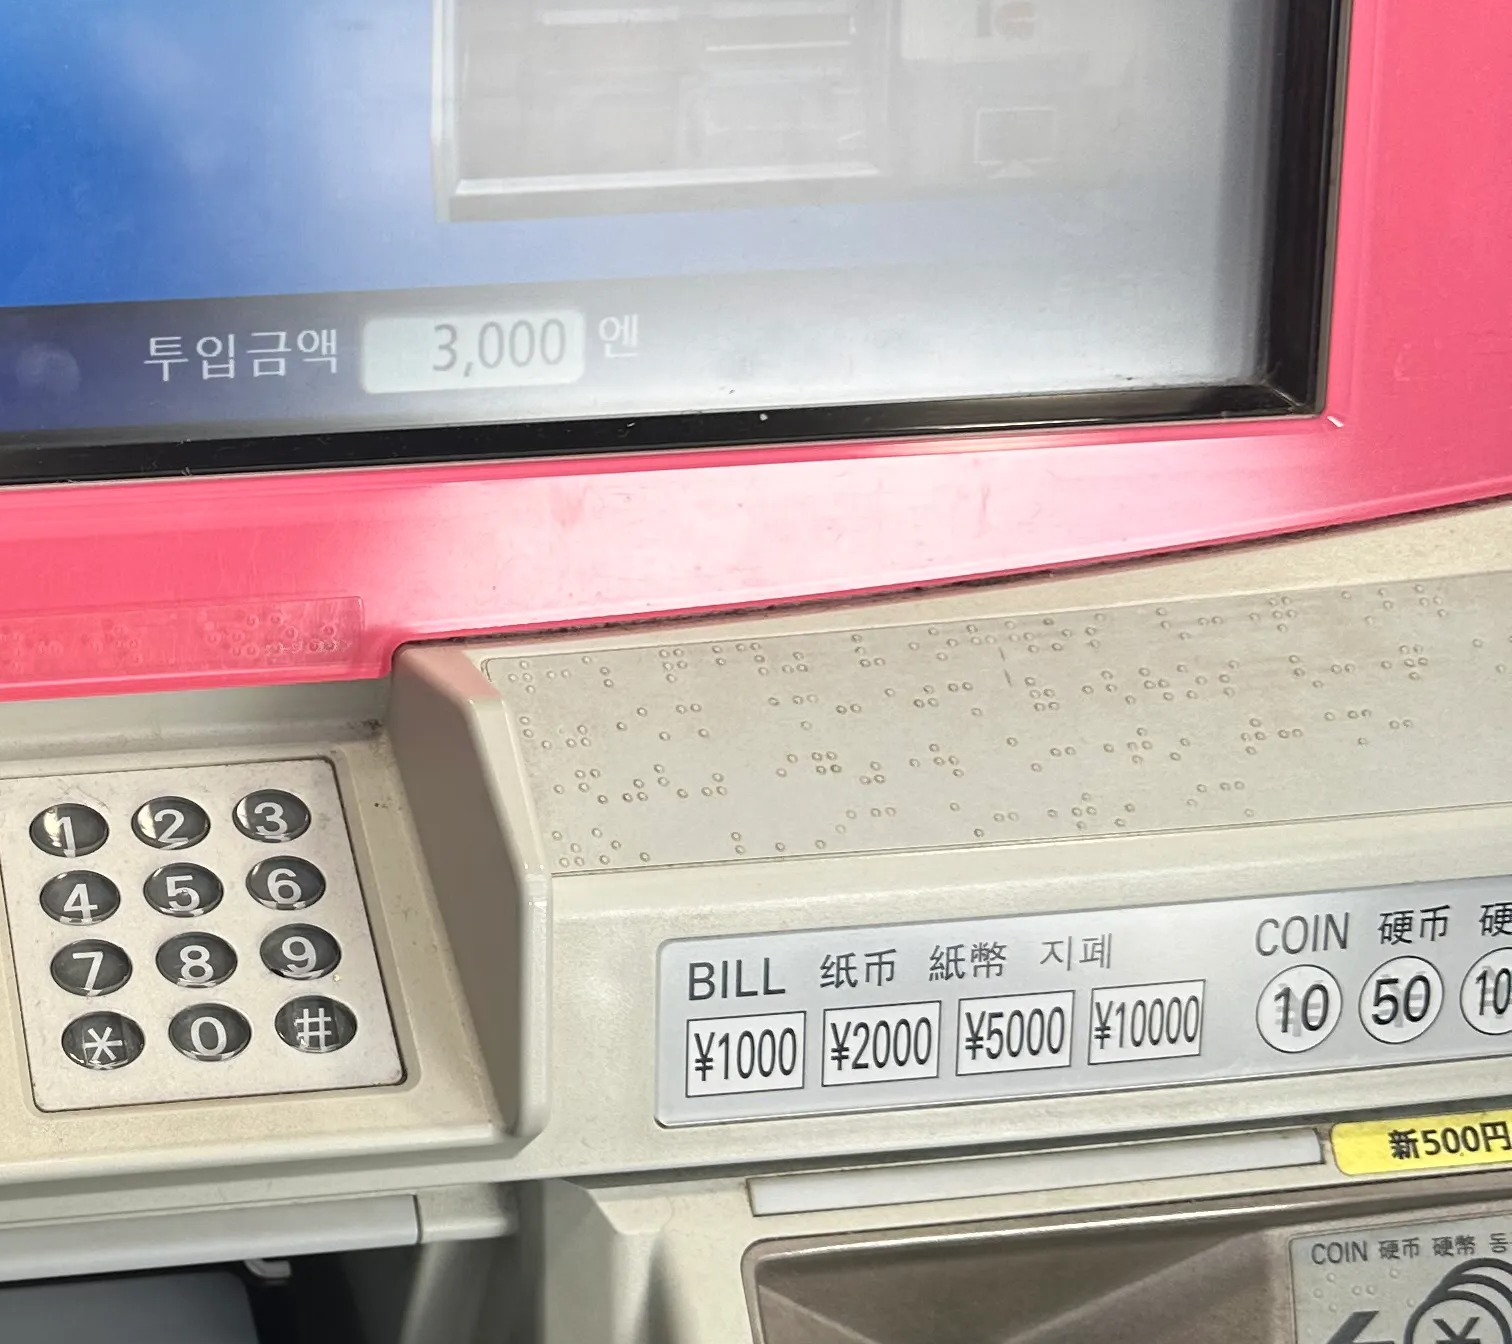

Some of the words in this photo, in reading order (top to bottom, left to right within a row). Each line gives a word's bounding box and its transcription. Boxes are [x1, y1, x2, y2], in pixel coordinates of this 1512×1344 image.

[144, 328, 339, 382] 투입금액
[431, 317, 567, 378] 3,000
[597, 314, 639, 360] 엔
[57, 816, 77, 856] 1
[155, 810, 188, 846] 2
[255, 802, 286, 839] 3
[63, 883, 98, 920] 4
[167, 876, 200, 912] 5
[268, 868, 301, 904] 6
[1255, 912, 1349, 957] COIN
[1377, 904, 1450, 946] 硬币
[73, 952, 104, 991] 7
[180, 944, 213, 983] 8
[283, 937, 317, 973] 9
[688, 956, 786, 1002] BILL
[820, 949, 896, 991] 纸币
[929, 943, 1008, 985] 紙幣
[1274, 983, 1329, 1033] 10
[1372, 974, 1431, 1025] 50
[1475, 968, 1512, 1016] 10
[695, 1027, 796, 1082] ¥1000
[830, 1017, 932, 1071] ¥2000
[965, 1006, 1066, 1061] ¥5000
[1094, 994, 1202, 1050] ¥10000
[1388, 1121, 1512, 1160] 新500円
[1311, 1241, 1368, 1265] COIN
[1379, 1237, 1420, 1259] 硬币
[1489, 1233, 1512, 1253] 동
